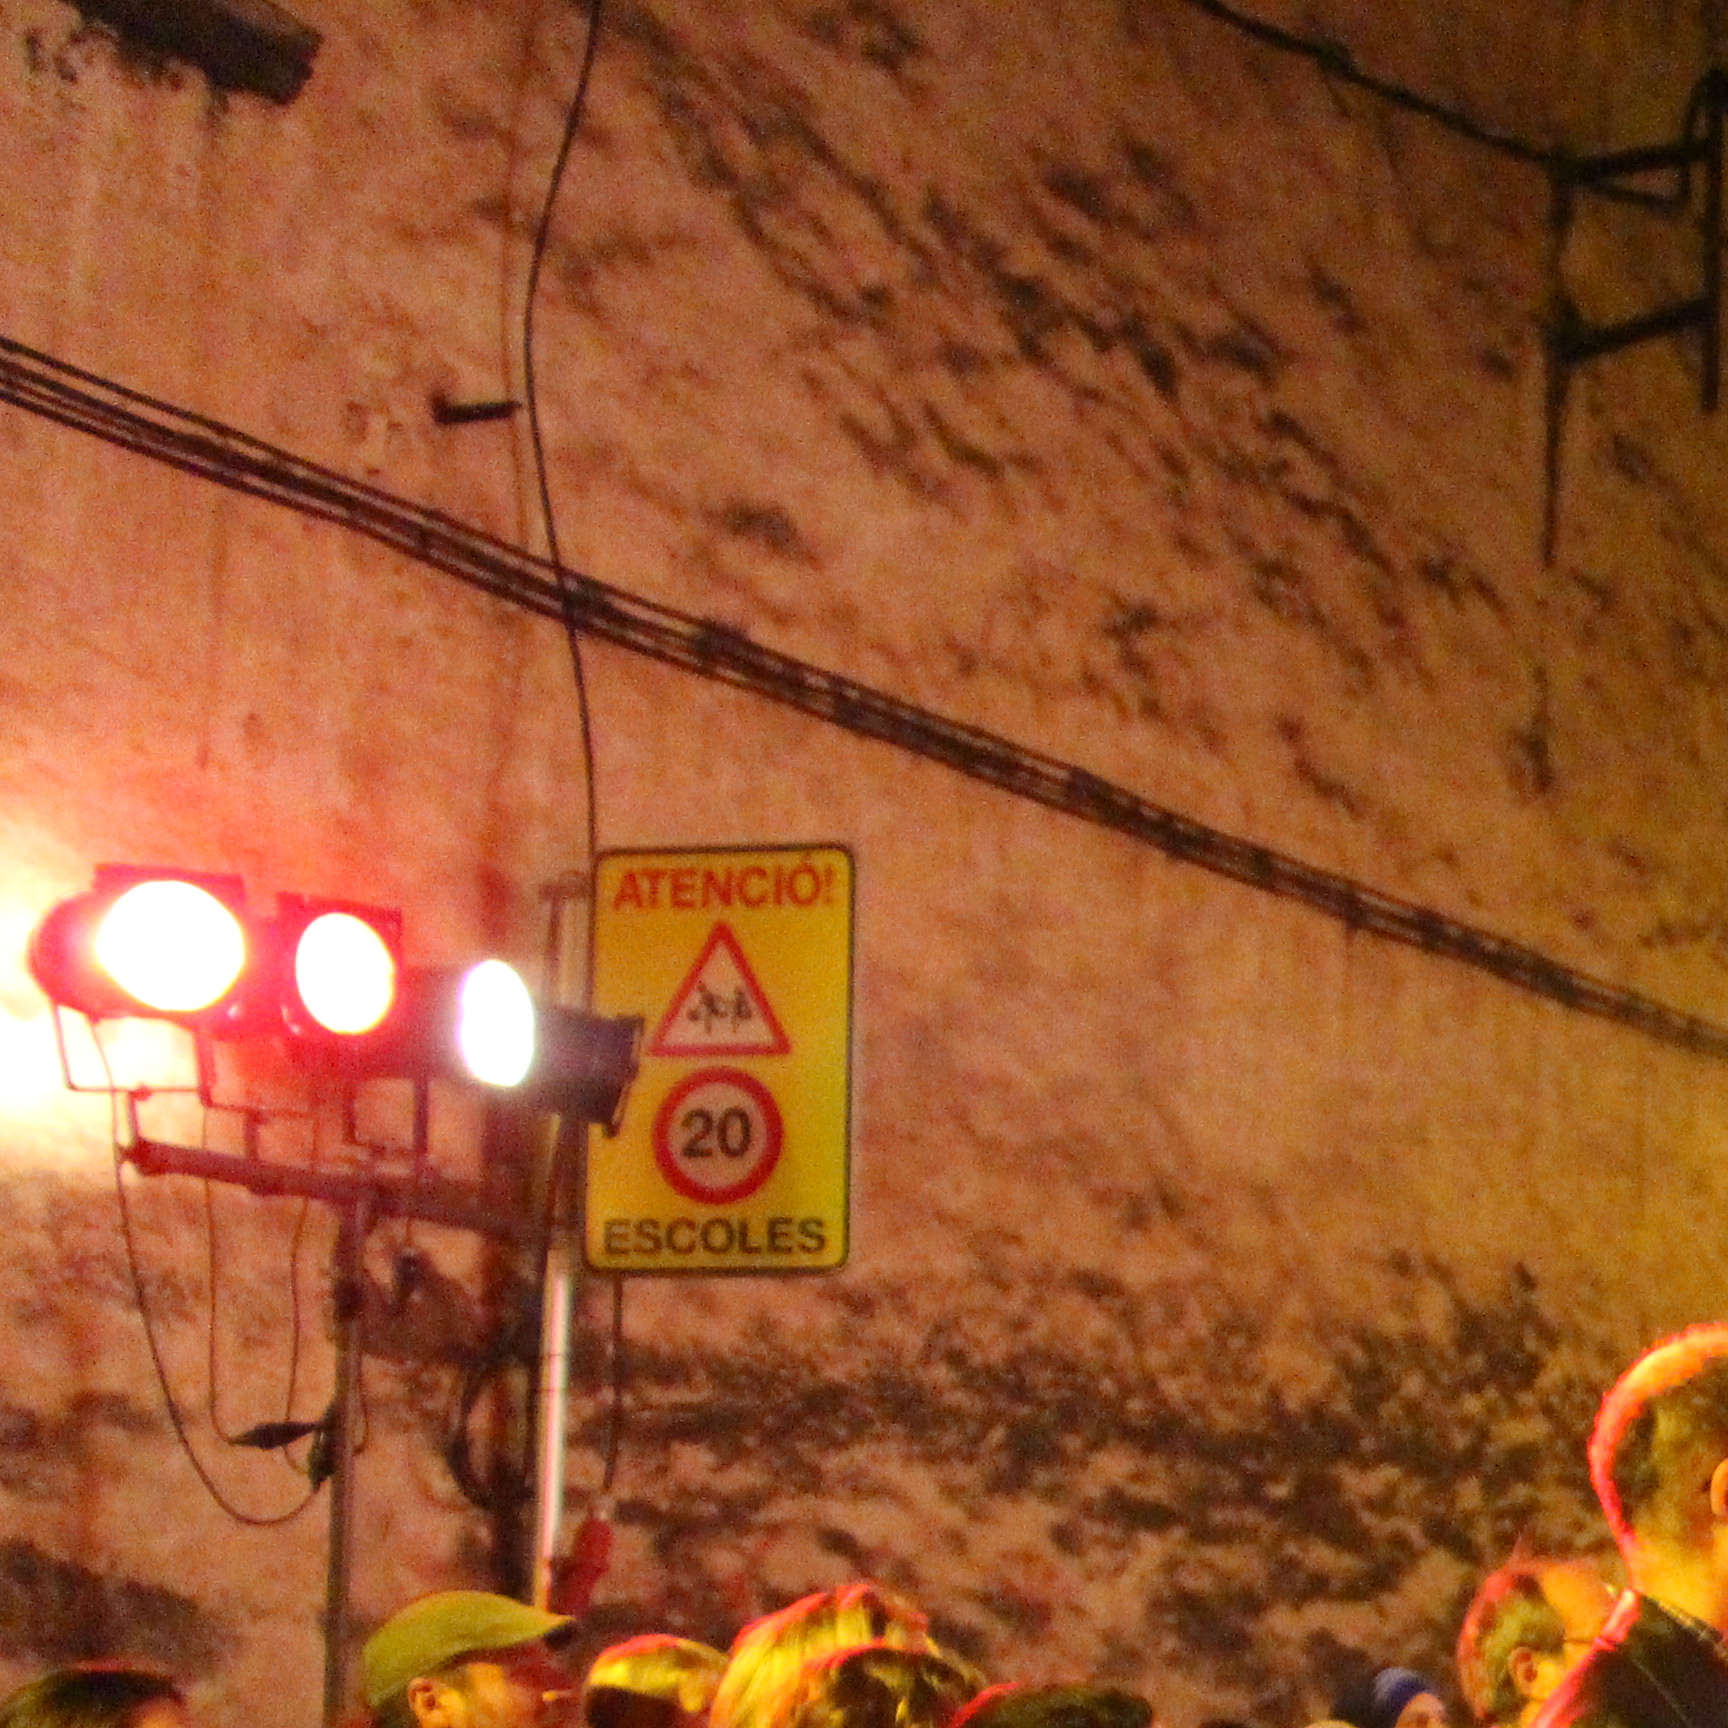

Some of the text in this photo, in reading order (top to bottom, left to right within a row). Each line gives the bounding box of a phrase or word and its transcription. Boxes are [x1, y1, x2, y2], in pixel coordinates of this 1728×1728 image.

[613, 853, 834, 911] ATENCIÓ!
[681, 1105, 752, 1159] 20
[604, 1216, 826, 1256] ESCOLES
